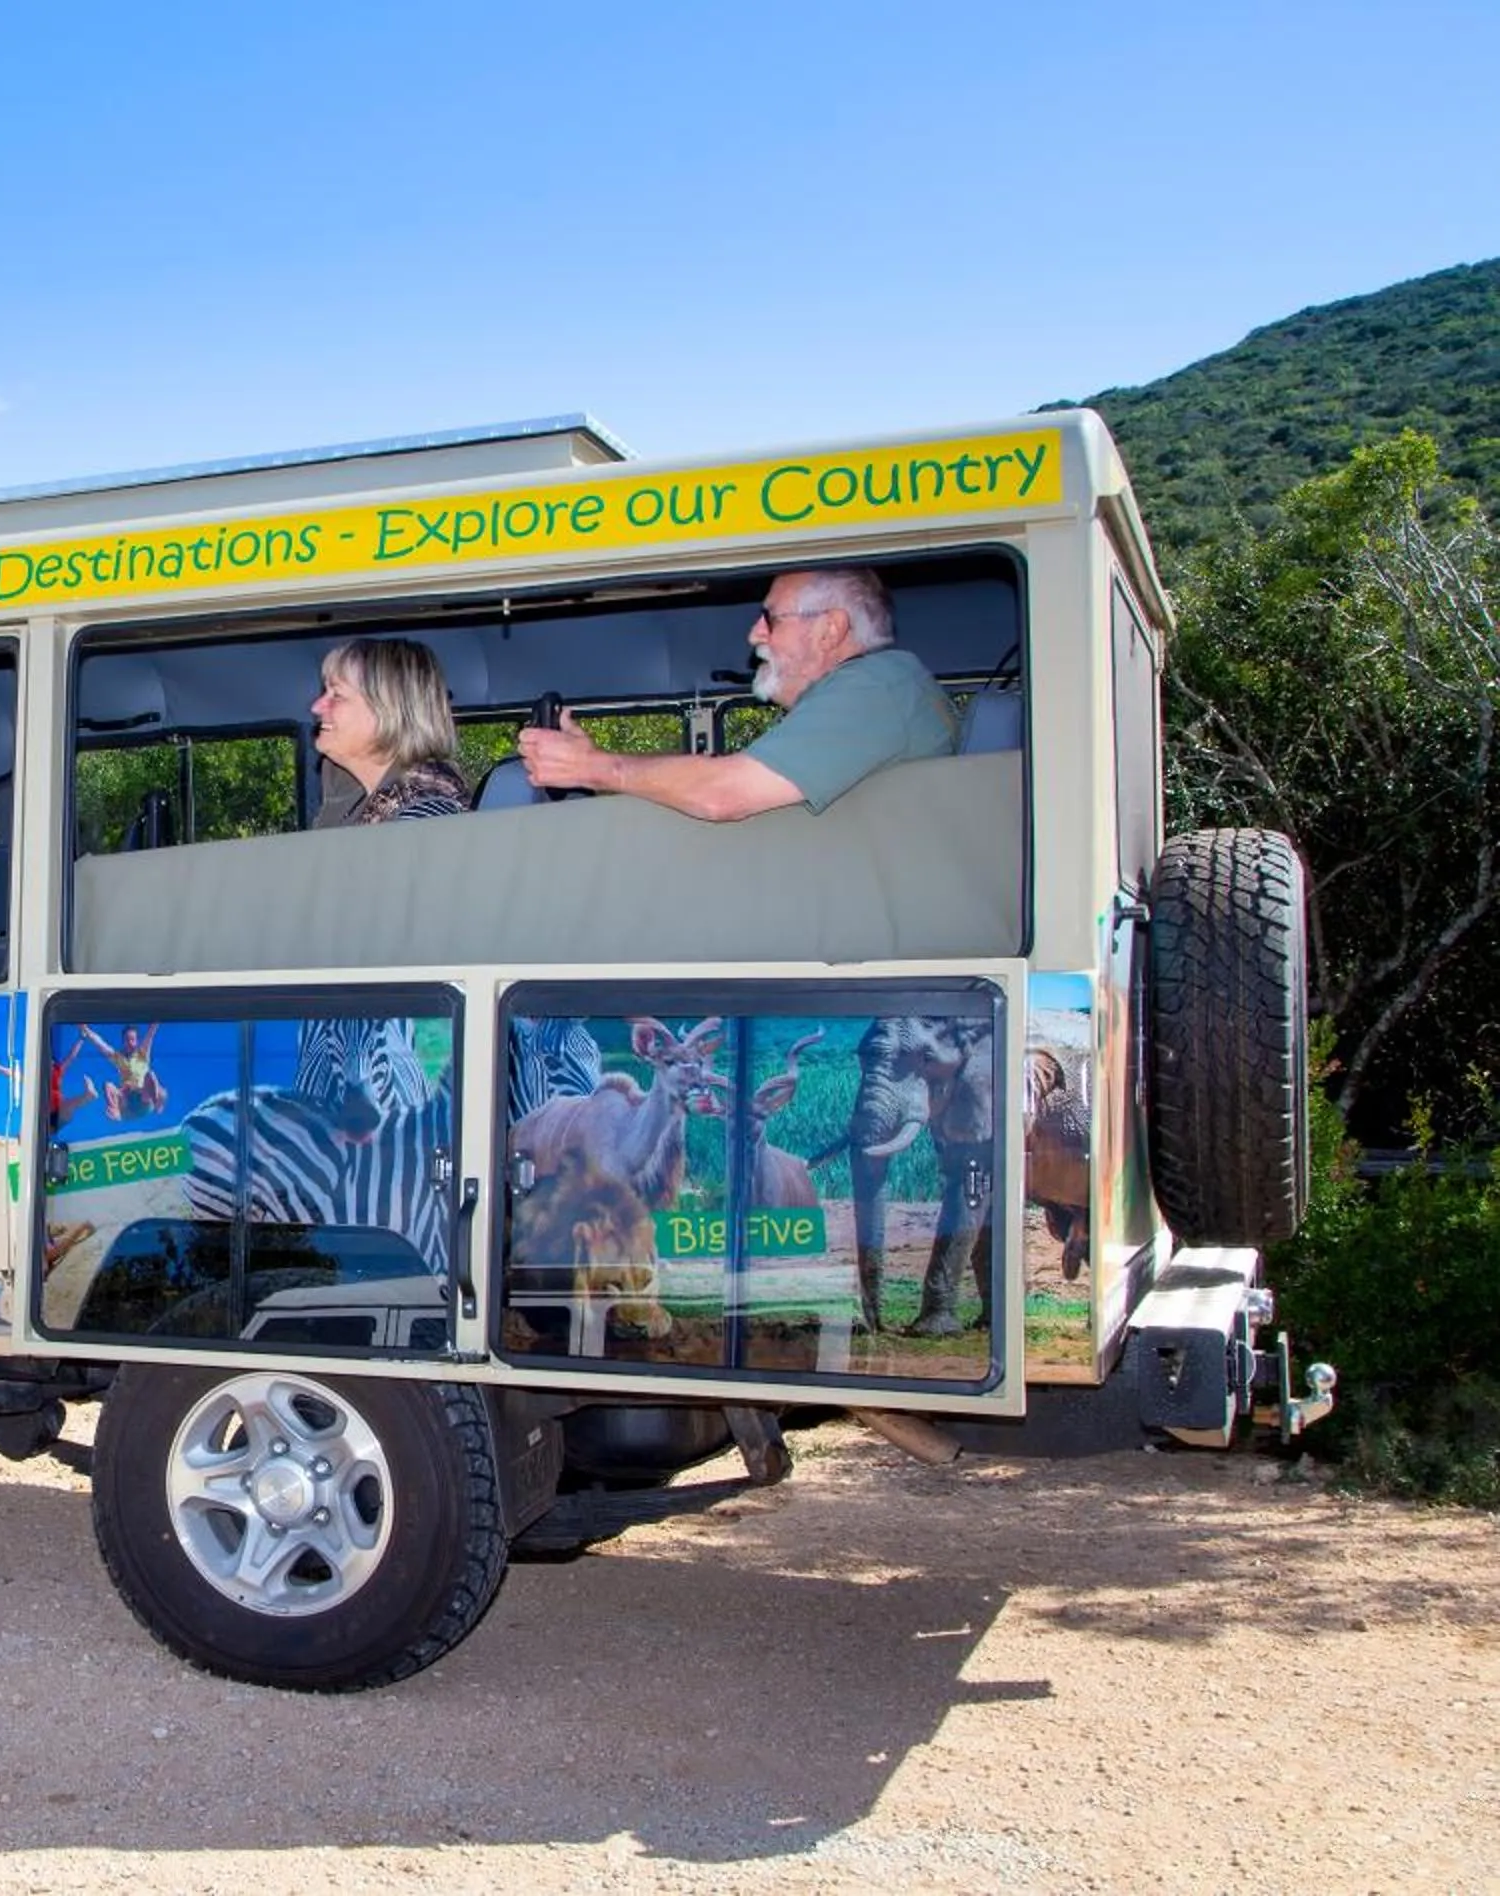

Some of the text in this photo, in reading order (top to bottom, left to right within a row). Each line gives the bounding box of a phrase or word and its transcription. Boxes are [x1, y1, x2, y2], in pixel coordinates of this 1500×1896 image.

[373, 494, 606, 562] Explore
[625, 480, 738, 527] our
[760, 442, 1048, 523] Country
[101, 1144, 184, 1182] Fever
[667, 1215, 815, 1254] Big Five
